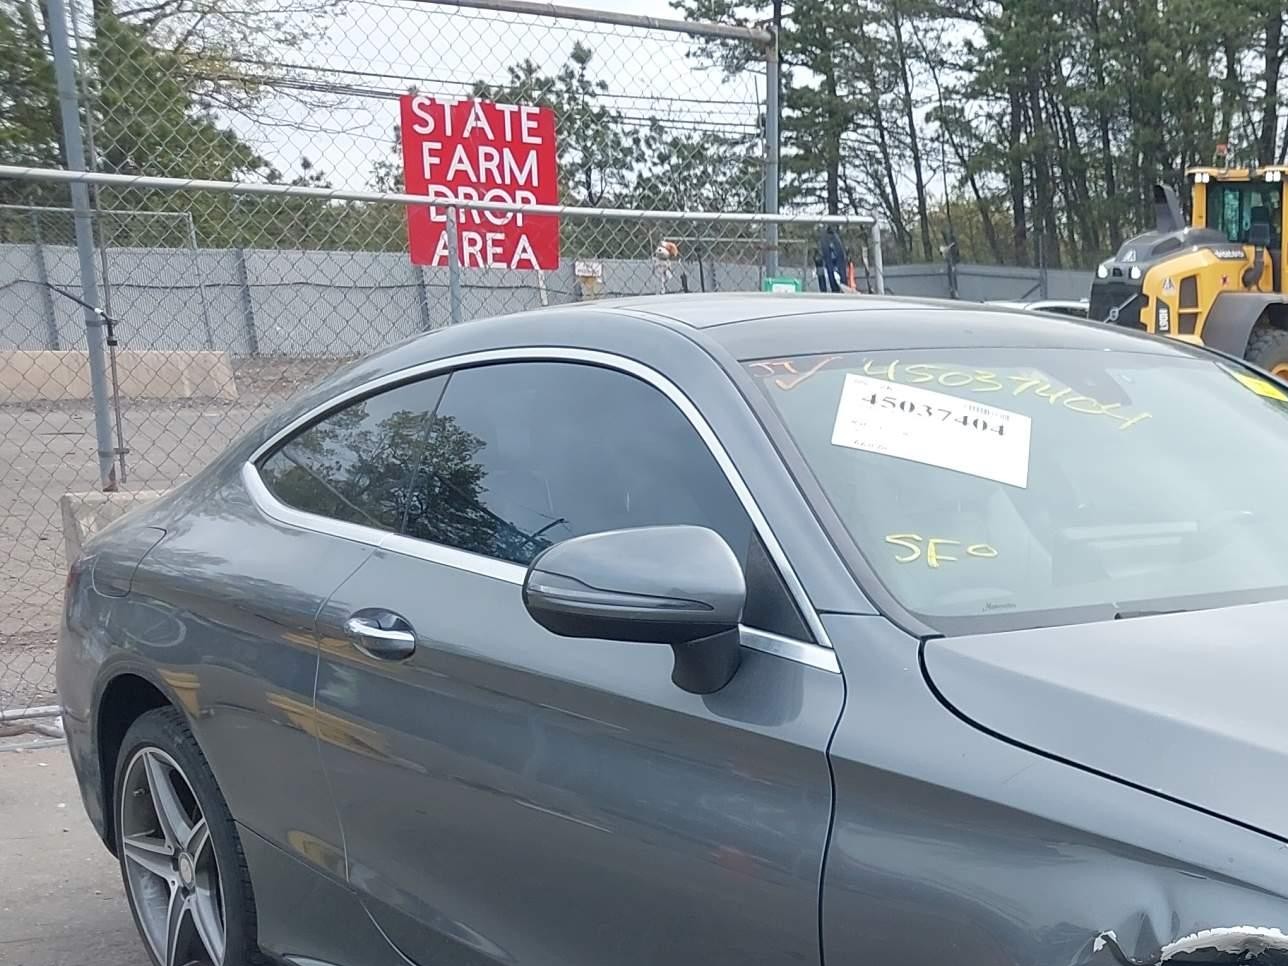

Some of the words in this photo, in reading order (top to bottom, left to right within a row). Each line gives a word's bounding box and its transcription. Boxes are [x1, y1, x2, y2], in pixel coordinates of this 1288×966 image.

[412, 95, 543, 145] STATE
[422, 141, 539, 187] FARM
[428, 184, 537, 227] DROP
[431, 231, 541, 270] AREA
[861, 392, 1005, 436] 45037404
